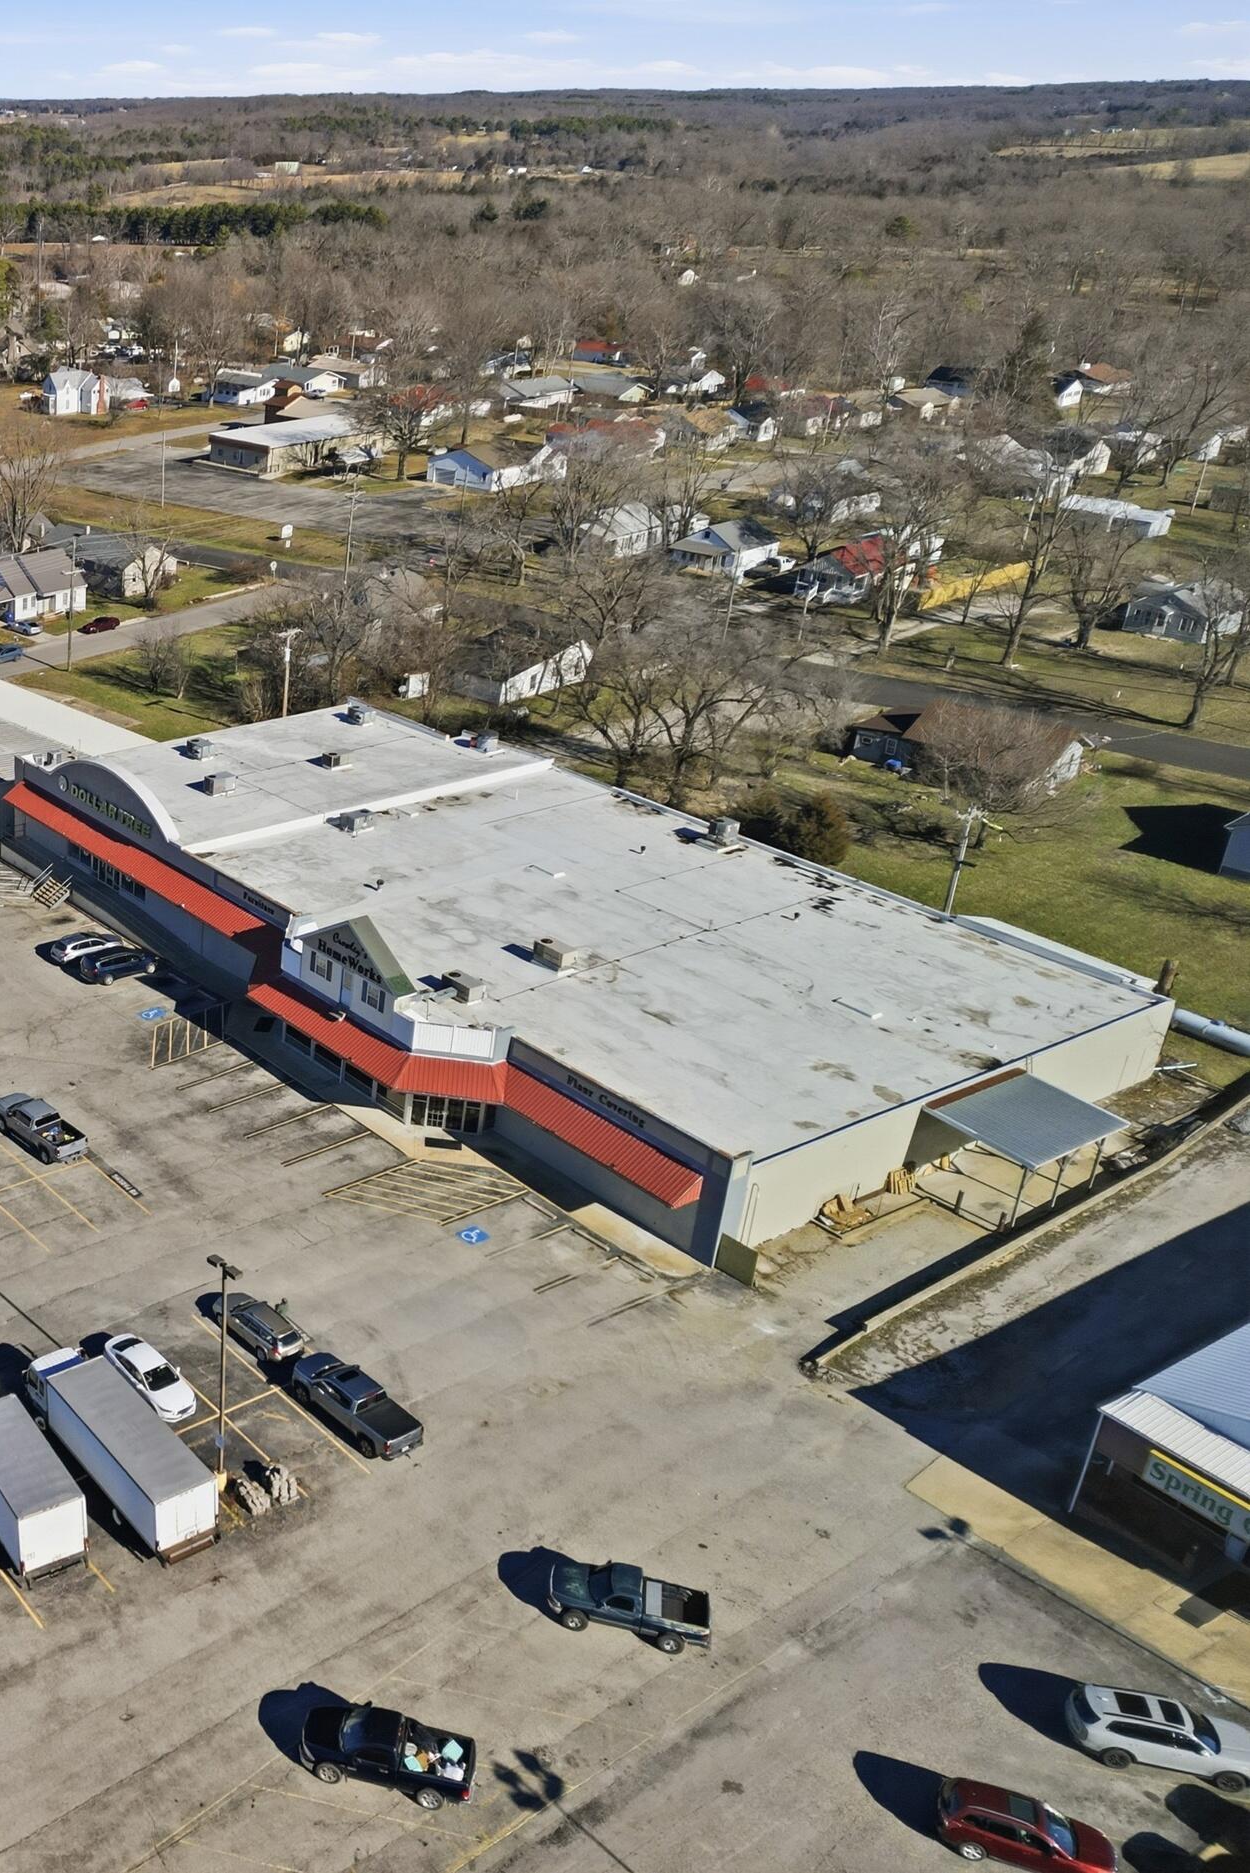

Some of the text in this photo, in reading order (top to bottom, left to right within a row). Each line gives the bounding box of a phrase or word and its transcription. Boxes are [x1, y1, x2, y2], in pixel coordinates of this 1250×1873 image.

[70, 785, 151, 839] DOLLAR TREE
[599, 1094, 646, 1128] Covering
[1150, 1461, 1233, 1526] Spring
